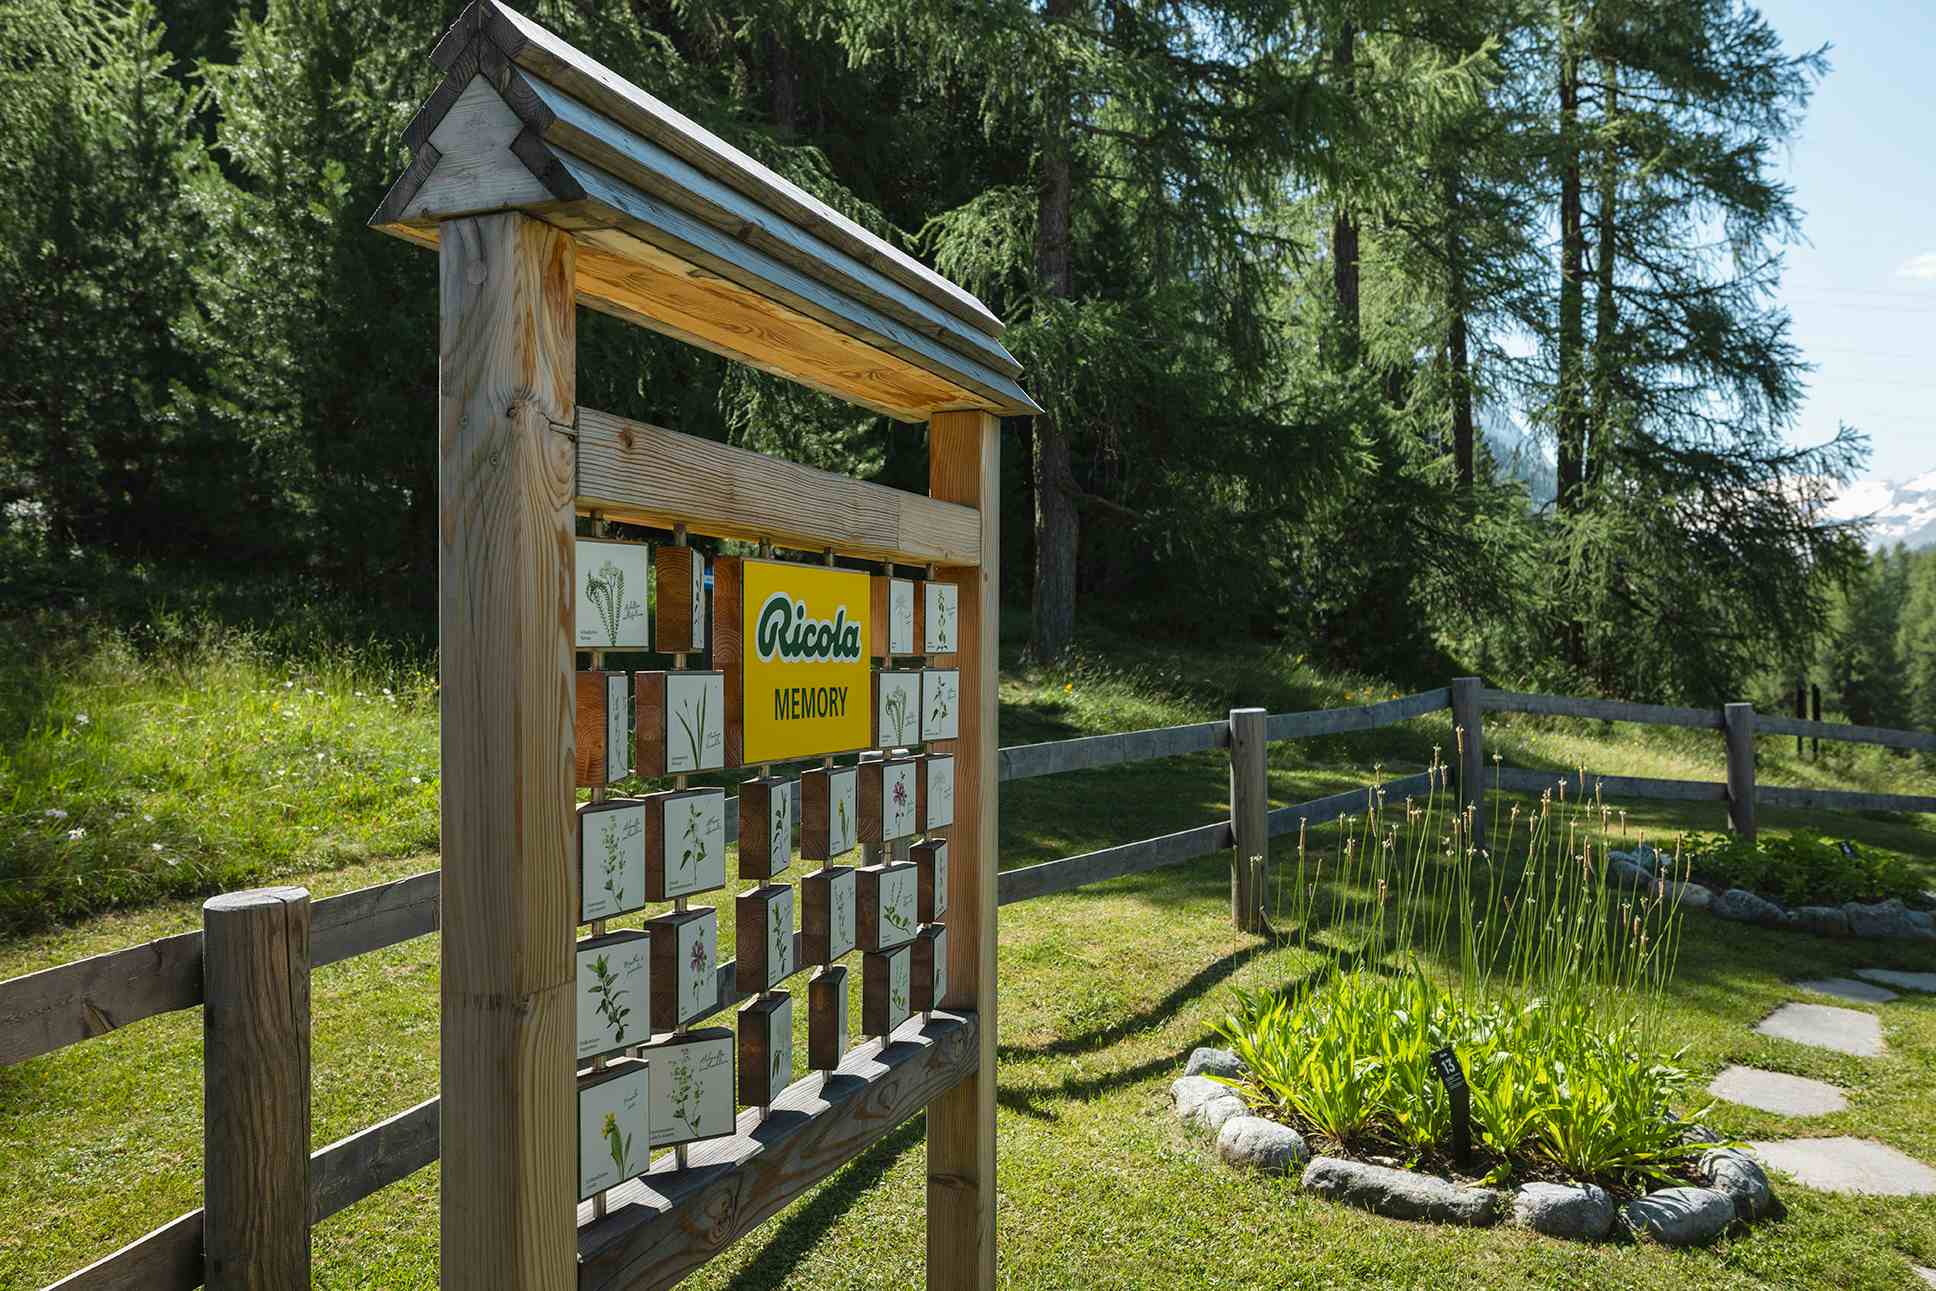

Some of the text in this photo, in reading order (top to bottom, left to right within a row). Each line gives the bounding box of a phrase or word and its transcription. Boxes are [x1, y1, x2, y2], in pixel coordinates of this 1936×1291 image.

[757, 595, 861, 659] Ricola
[774, 686, 849, 721] MEMORY
[1441, 1057, 1456, 1075] 13
